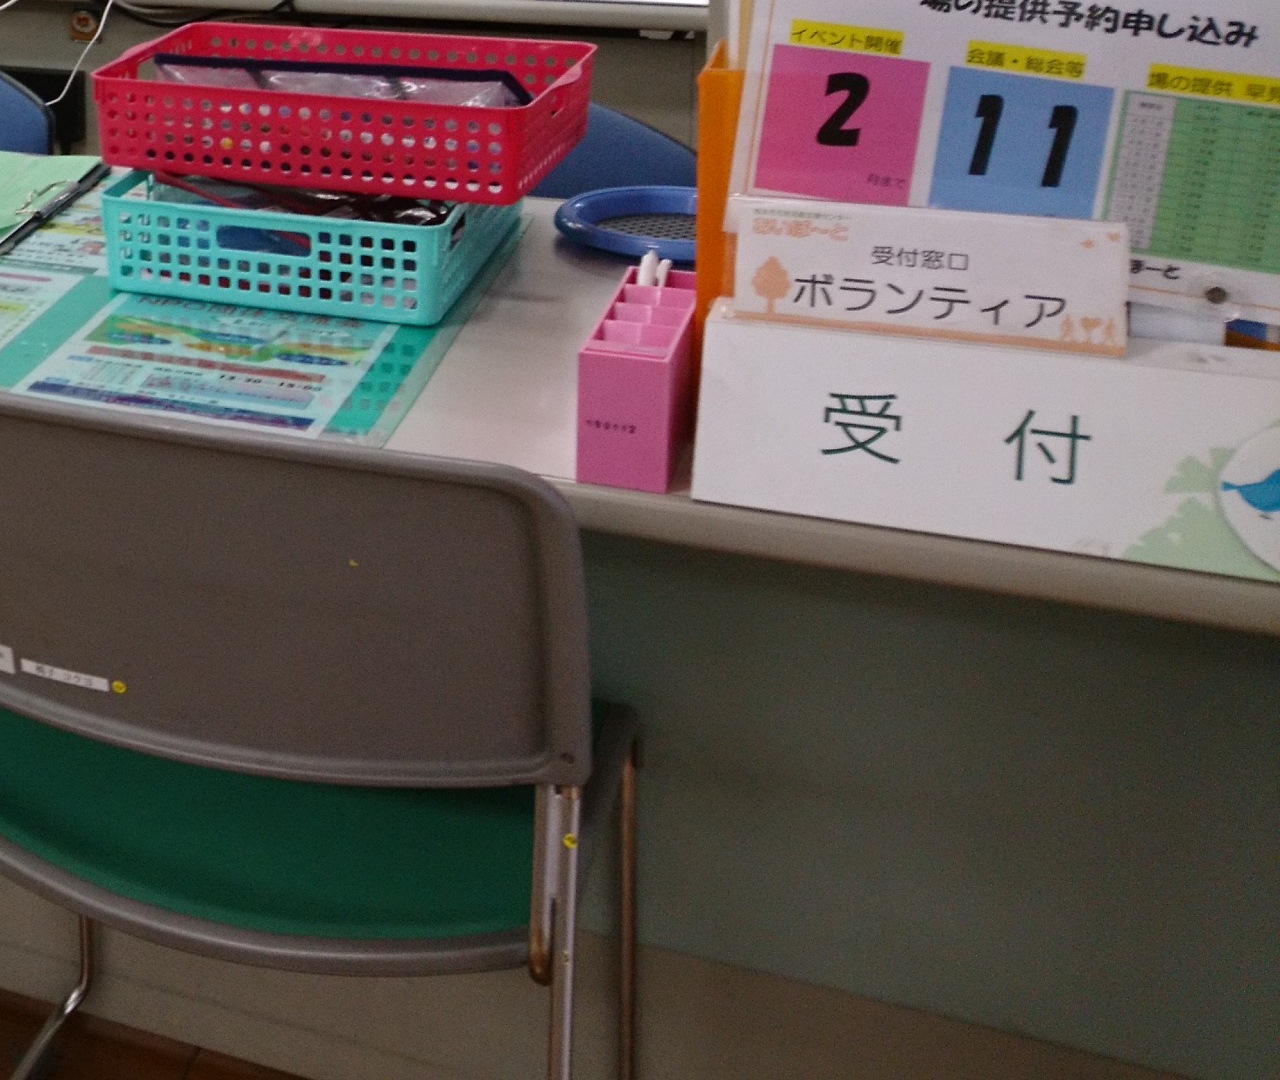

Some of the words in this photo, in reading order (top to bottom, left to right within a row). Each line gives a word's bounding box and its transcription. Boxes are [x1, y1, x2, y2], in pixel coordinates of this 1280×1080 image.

[790, 24, 904, 57] イベント開催
[966, 45, 1086, 80] 会議・総会等
[815, 71, 871, 147] 2
[871, 246, 970, 271] 受付窓口
[792, 273, 1067, 329] ボランティア
